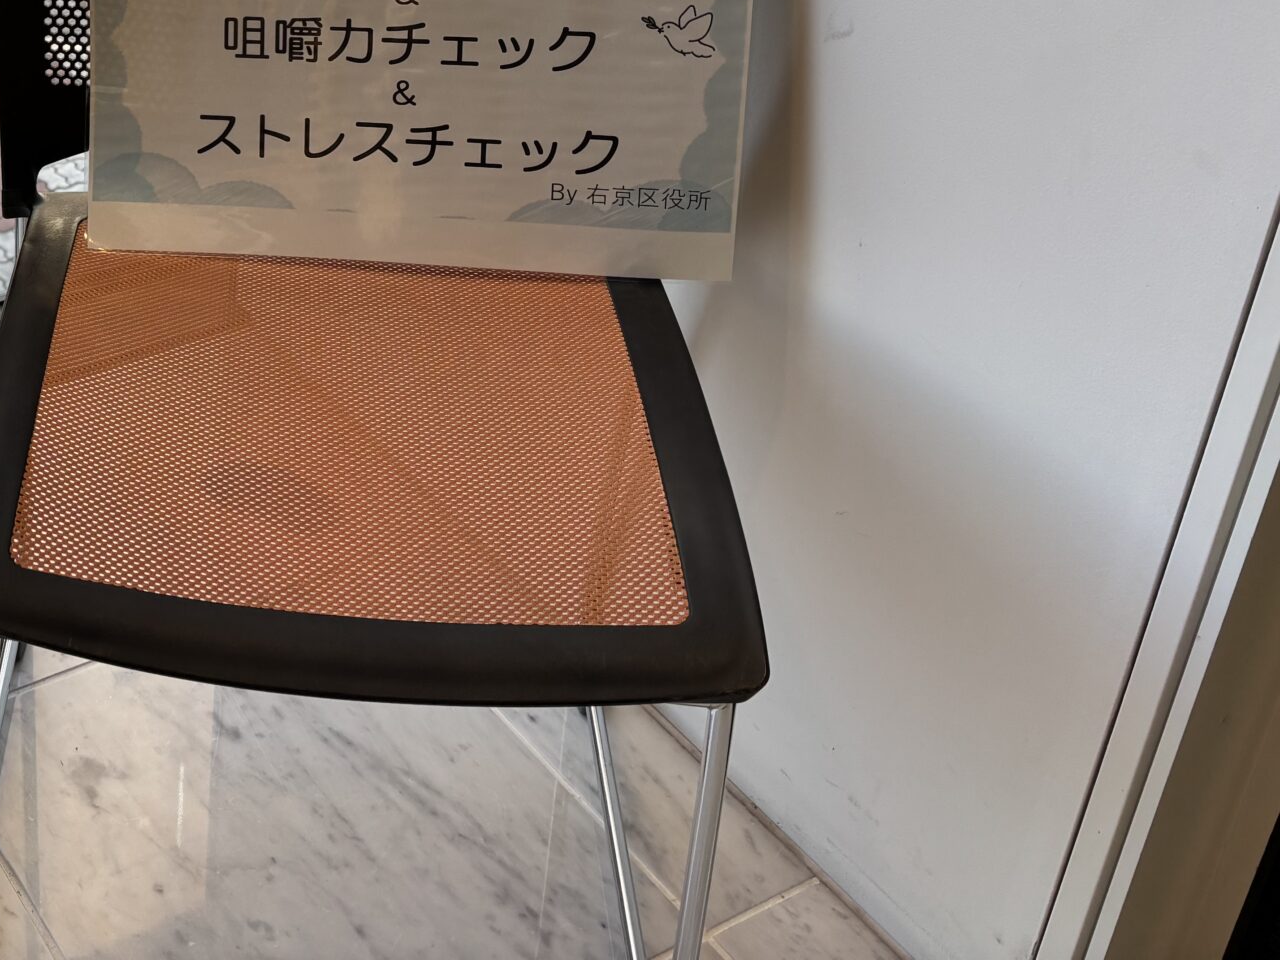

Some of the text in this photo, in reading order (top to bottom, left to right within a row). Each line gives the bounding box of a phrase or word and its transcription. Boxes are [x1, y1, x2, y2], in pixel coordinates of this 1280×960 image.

[223, 16, 597, 72] 咀嚼力チェック
[392, 80, 417, 106] &
[197, 113, 620, 176] ストレスチェック
[550, 182, 712, 211] By 右京区役所
